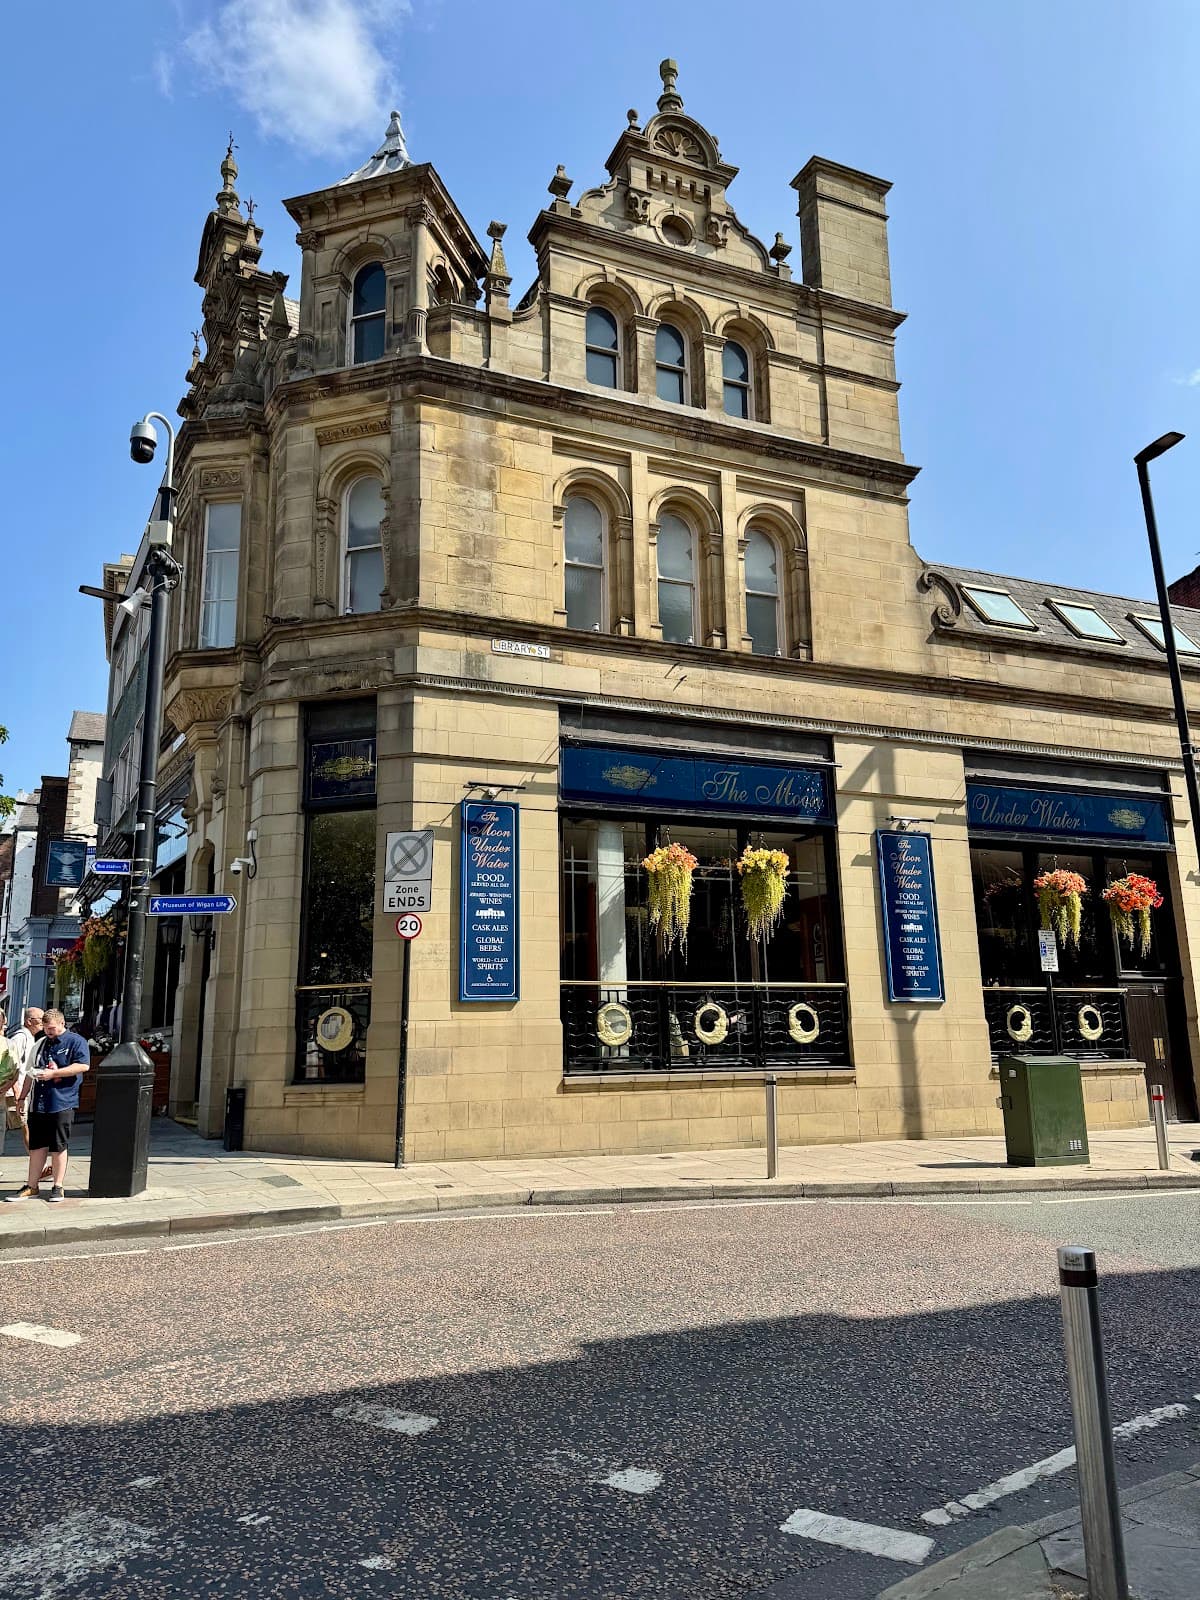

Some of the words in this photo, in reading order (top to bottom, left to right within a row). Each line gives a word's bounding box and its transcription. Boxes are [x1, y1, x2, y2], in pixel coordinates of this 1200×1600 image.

[493, 640, 532, 654] LIBRARY
[537, 646, 549, 656] ST
[702, 770, 749, 802] The
[755, 776, 823, 808] Moon
[481, 811, 499, 822] The
[972, 793, 1029, 825] Under
[1030, 798, 1081, 829] Water
[470, 822, 511, 838] Moon
[470, 837, 511, 852] Under
[471, 853, 509, 869] Water
[890, 849, 922, 862] Moon
[891, 861, 922, 875] Under
[477, 873, 505, 882] FOOD
[894, 875, 923, 889] Water
[395, 885, 419, 894] Zone
[388, 895, 425, 908] ENDS
[479, 897, 502, 905] WINES
[898, 892, 920, 901] FOOD
[399, 920, 418, 932] 20
[491, 924, 509, 932] ALES
[475, 936, 505, 944] GLOBAL
